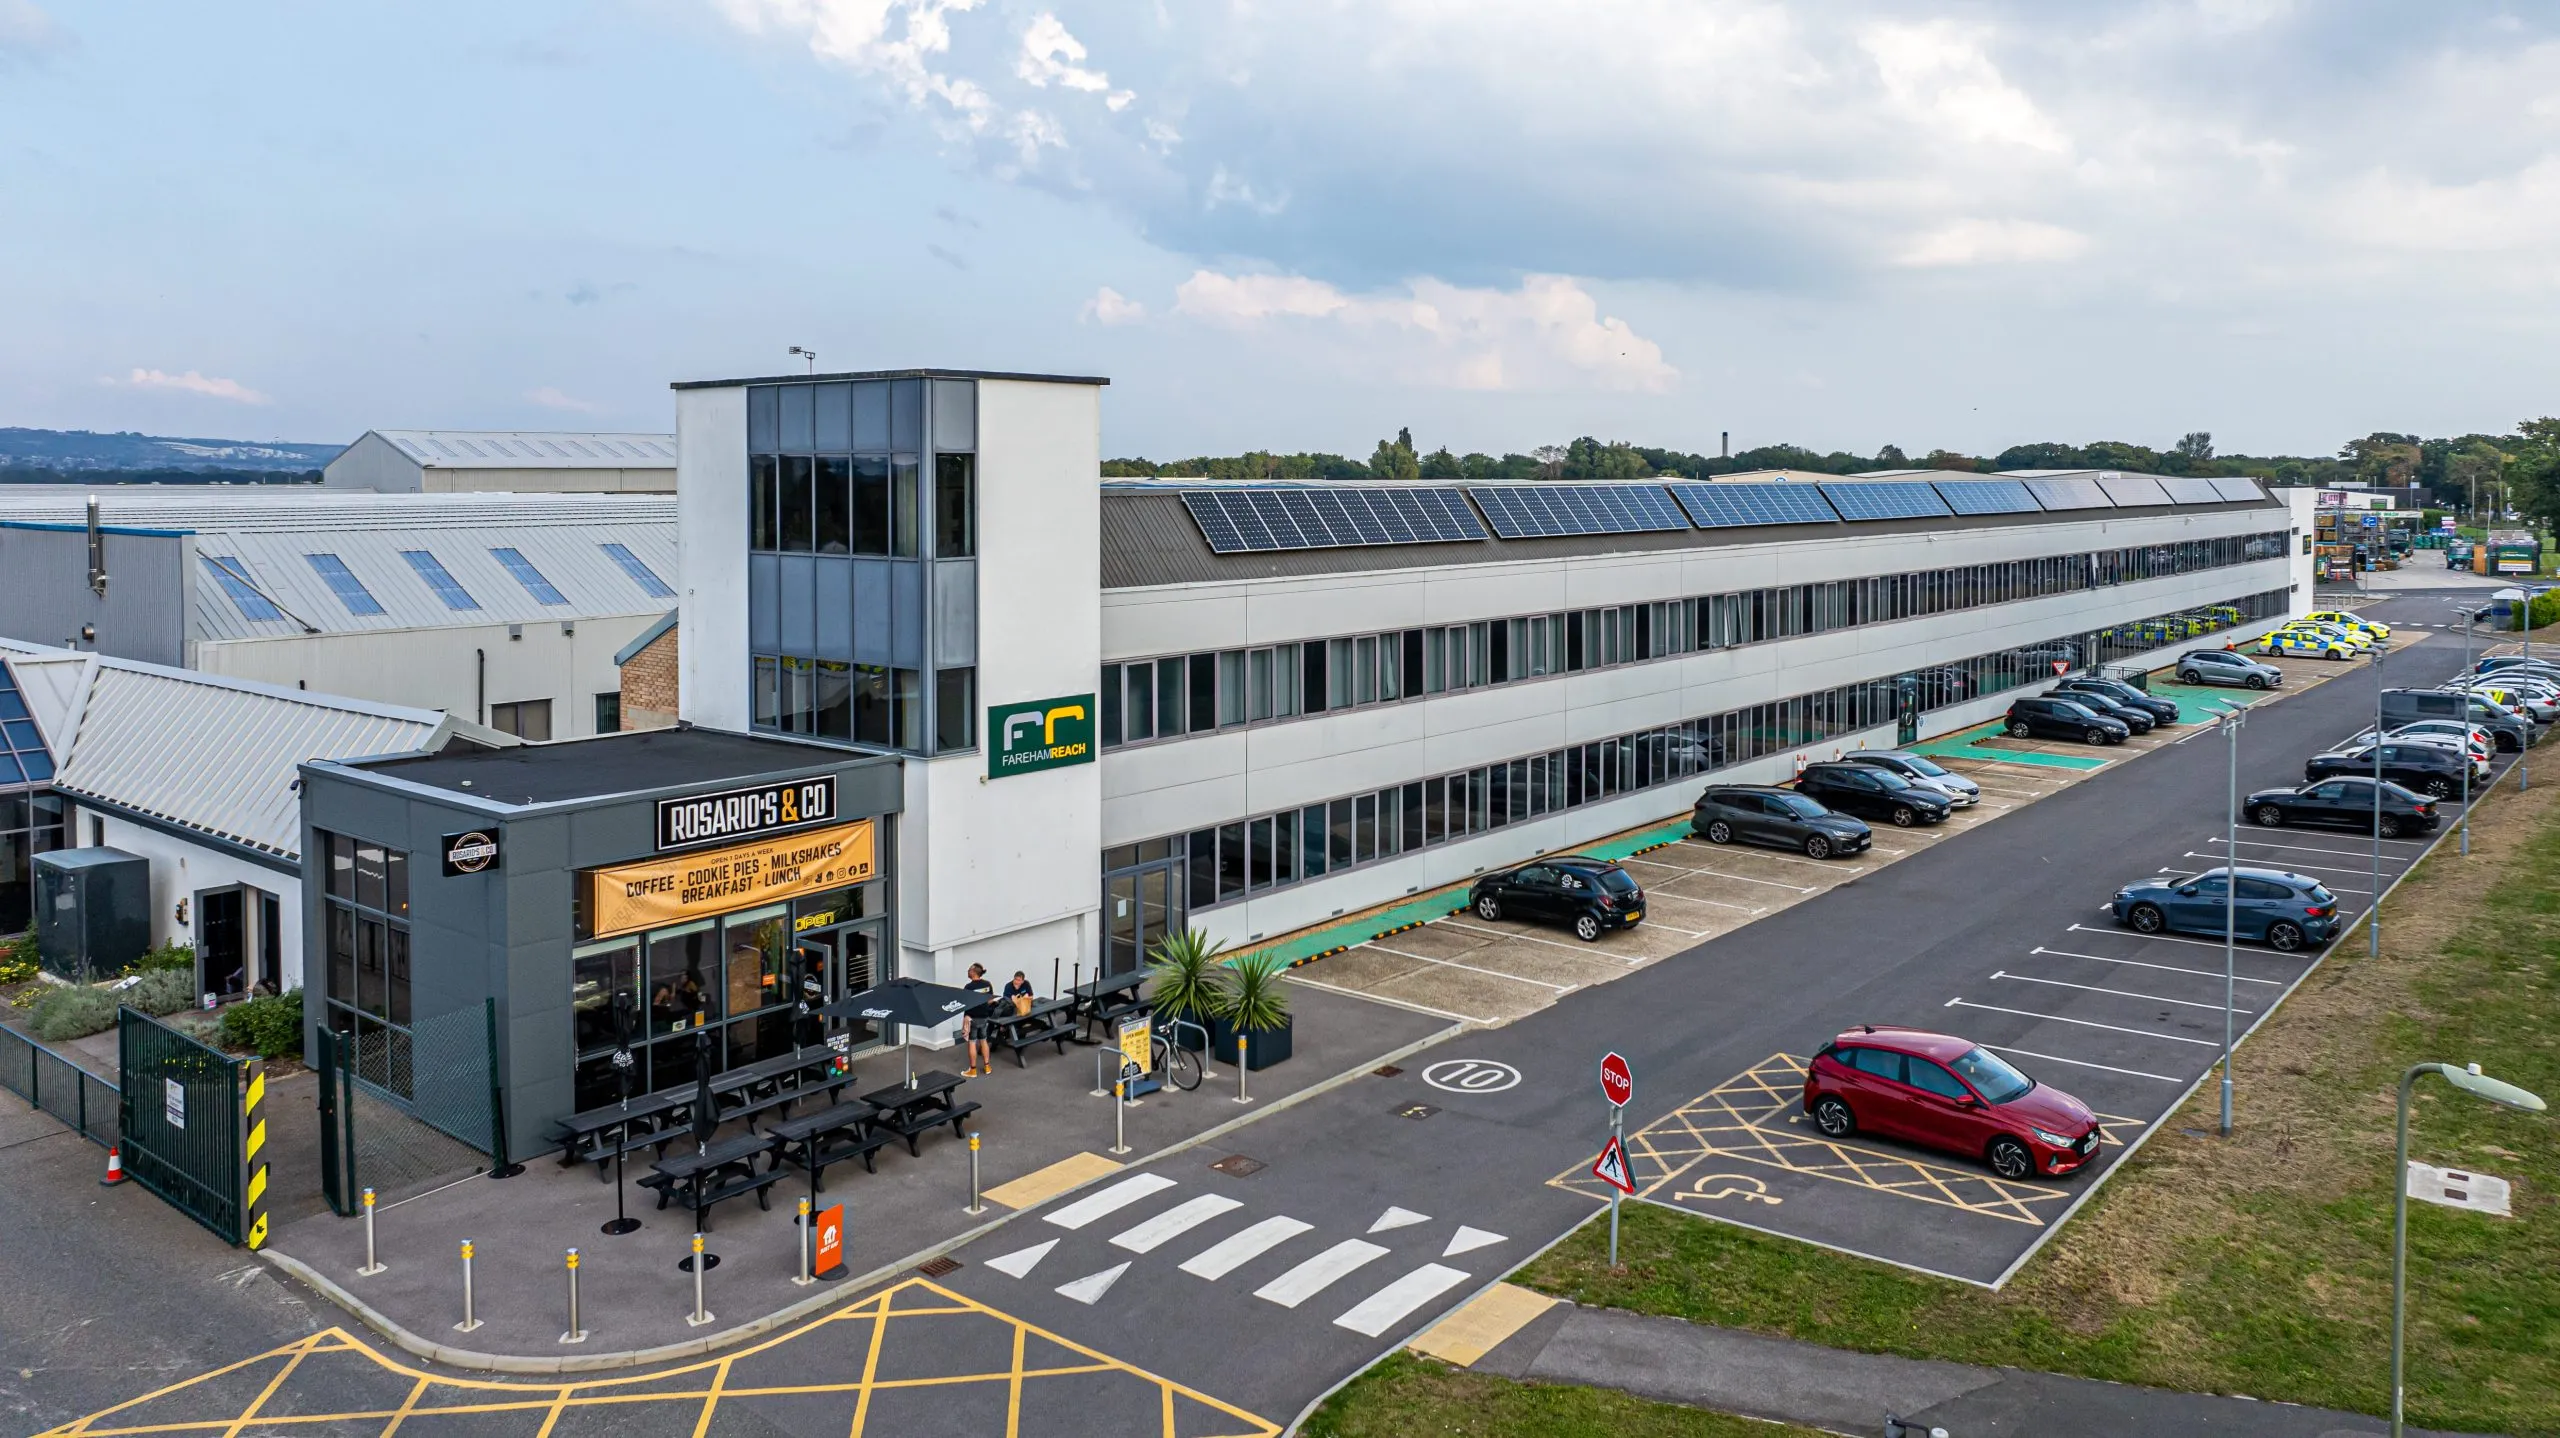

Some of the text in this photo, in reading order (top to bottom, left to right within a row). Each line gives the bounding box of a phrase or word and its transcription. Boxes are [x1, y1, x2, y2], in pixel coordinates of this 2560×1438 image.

[671, 784, 826, 841] ROSARIO'S & CO
[626, 875, 675, 898] COFFEE
[688, 864, 730, 887] COOKIE
[734, 858, 760, 878] PIES
[771, 842, 842, 870] MILKSHAKES
[711, 857, 729, 865] OPEN
[734, 852, 750, 860] DAYS
[682, 876, 754, 904] BREAKFAST
[764, 866, 801, 887] LUNCH
[795, 912, 835, 932] OPEN
[1440, 1063, 1504, 1088] 10
[1604, 1067, 1630, 1090] STOP
